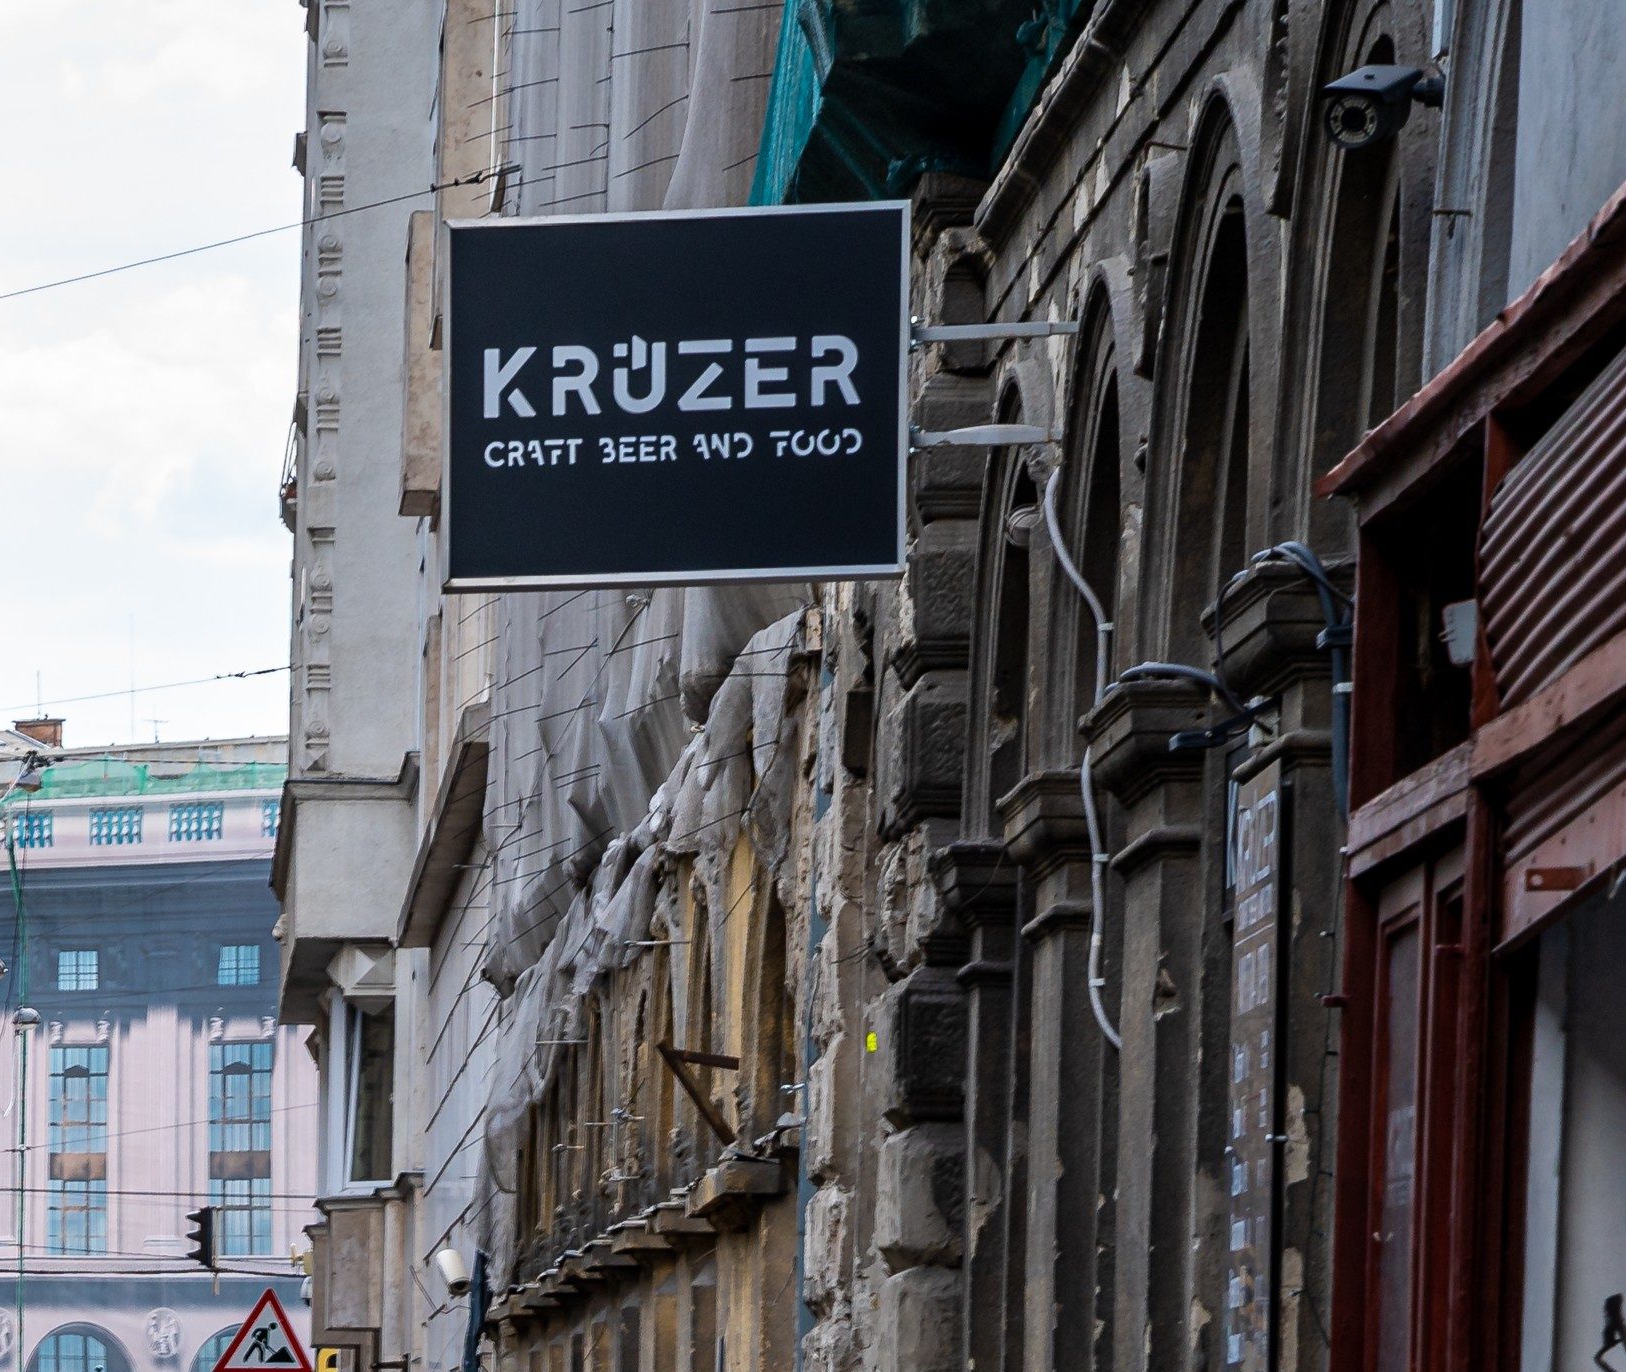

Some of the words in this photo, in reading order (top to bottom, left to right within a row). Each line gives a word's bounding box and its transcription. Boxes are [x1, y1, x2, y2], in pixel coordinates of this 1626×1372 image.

[484, 437, 583, 468] CRAFT
[598, 434, 678, 464] BEER
[692, 431, 754, 460] AND
[769, 427, 864, 457] FOOD
